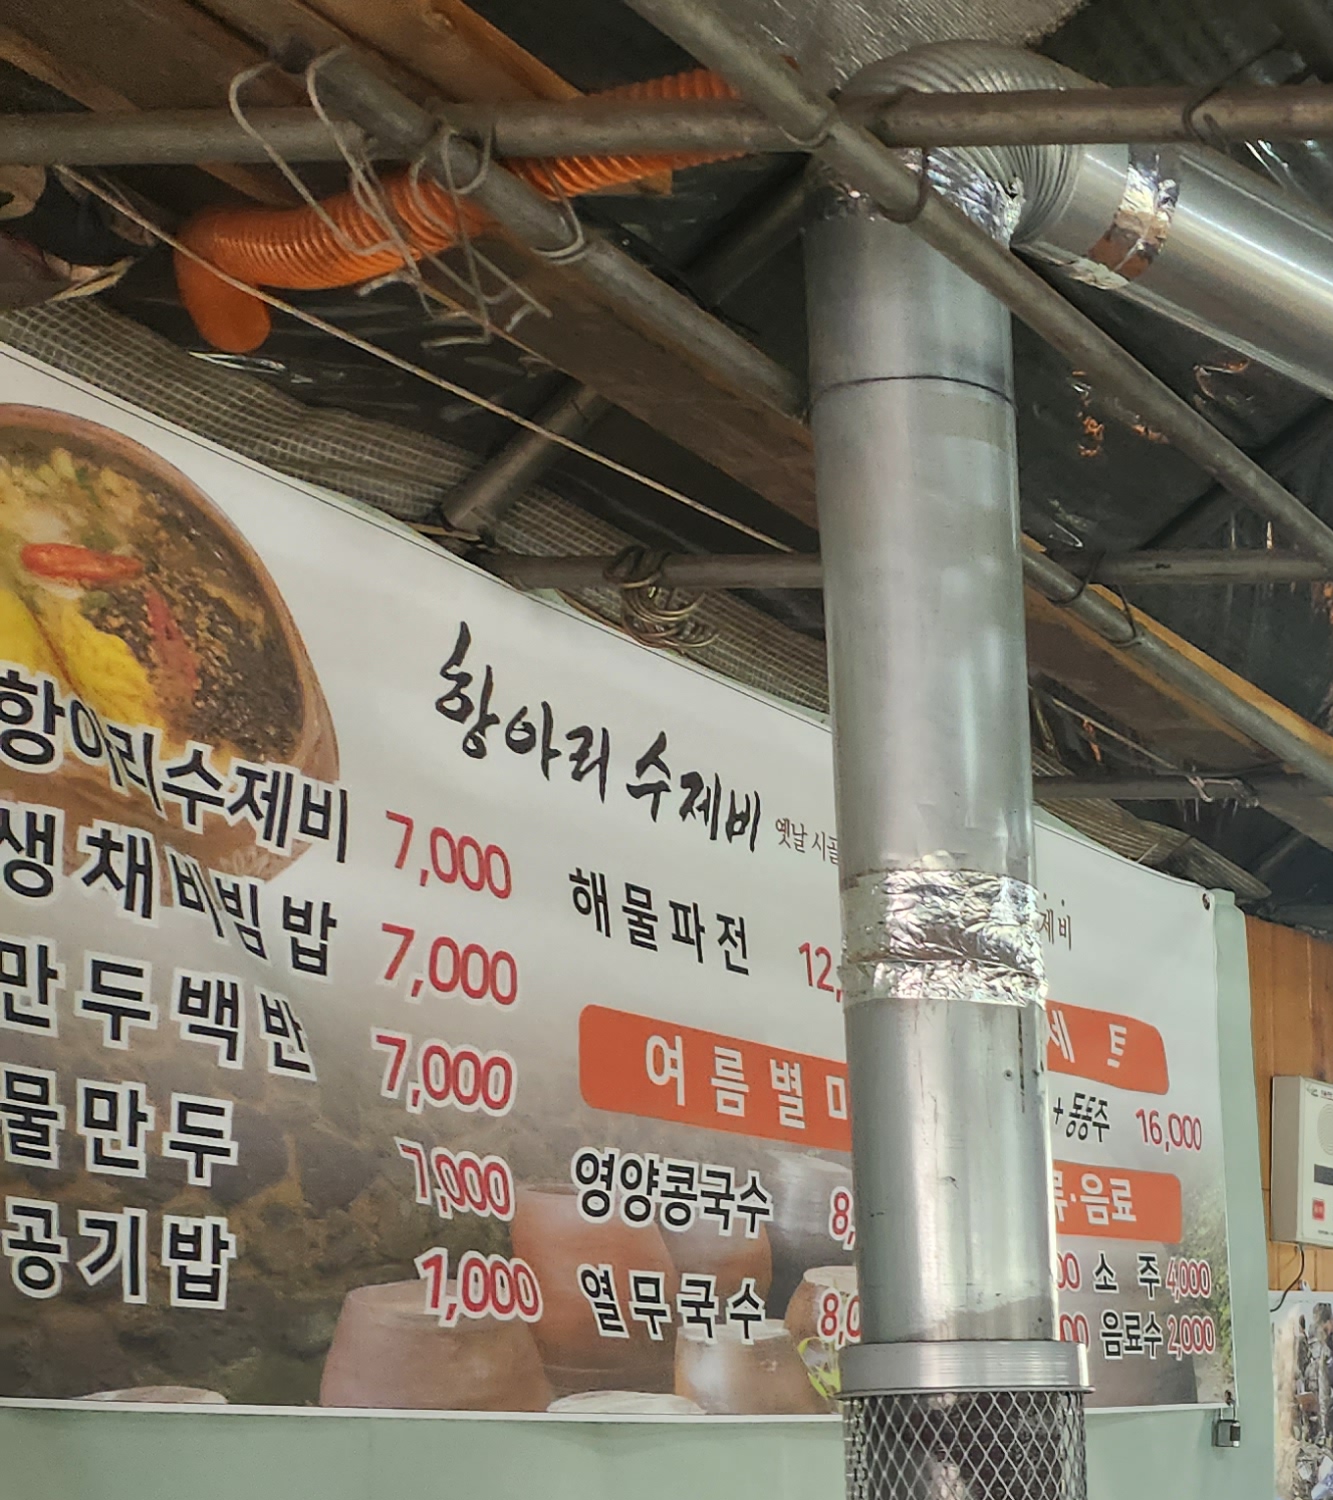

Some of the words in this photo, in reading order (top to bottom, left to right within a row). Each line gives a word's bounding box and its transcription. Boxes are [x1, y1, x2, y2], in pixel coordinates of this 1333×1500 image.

[435, 620, 610, 804] 항아리
[625, 730, 761, 853] 수제비
[0, 669, 349, 864] 항아리수제비
[385, 809, 512, 899] 7,000
[775, 817, 808, 853] 옛날
[381, 921, 519, 1006] 7,000
[568, 866, 750, 976] 해물파전
[0, 938, 312, 1075] 만두백반
[374, 1034, 515, 1111] 7,000
[1, 1067, 233, 1182] 물만두
[397, 1140, 514, 1216] 7,000
[1135, 1108, 1202, 1152] 16,000
[575, 1152, 770, 1233] 영양콩국수
[6, 1206, 231, 1306] 공기밥
[420, 1255, 541, 1322] 1,000
[581, 1269, 762, 1340] 열무국수
[1094, 1252, 1160, 1298] 소주
[1166, 1259, 1212, 1302] 4,000
[1101, 1311, 1162, 1358] 음료수
[1167, 1316, 1215, 1360] 2,000
